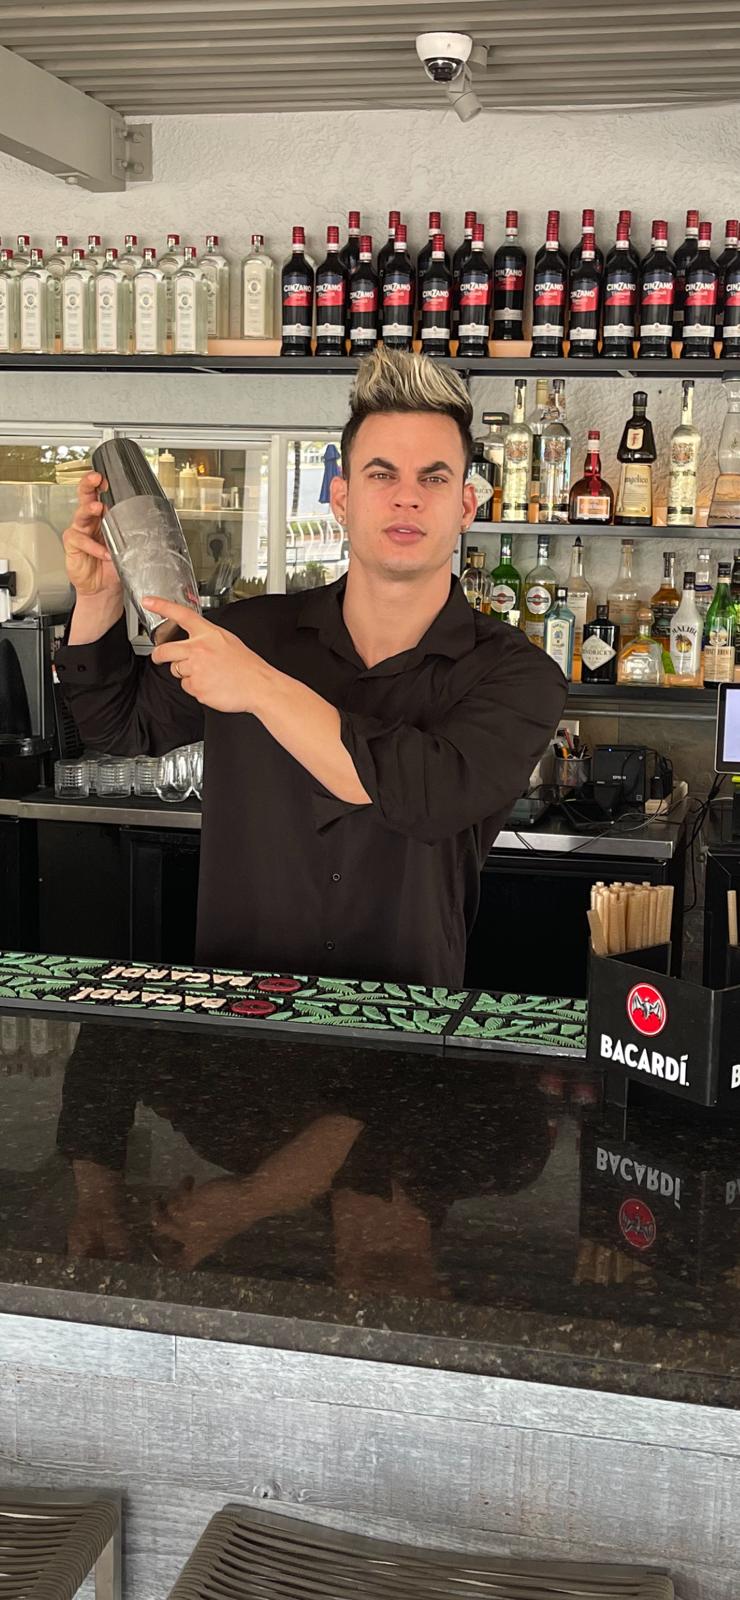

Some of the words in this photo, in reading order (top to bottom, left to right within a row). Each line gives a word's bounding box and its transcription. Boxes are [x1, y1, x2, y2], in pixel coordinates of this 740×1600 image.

[283, 283, 312, 293] CINZANO
[459, 281, 489, 292] CINZANO
[534, 281, 564, 291] CINZANO
[606, 281, 637, 292] CINZANO
[643, 281, 673, 291] CINZANO
[685, 281, 715, 292] CINZANO
